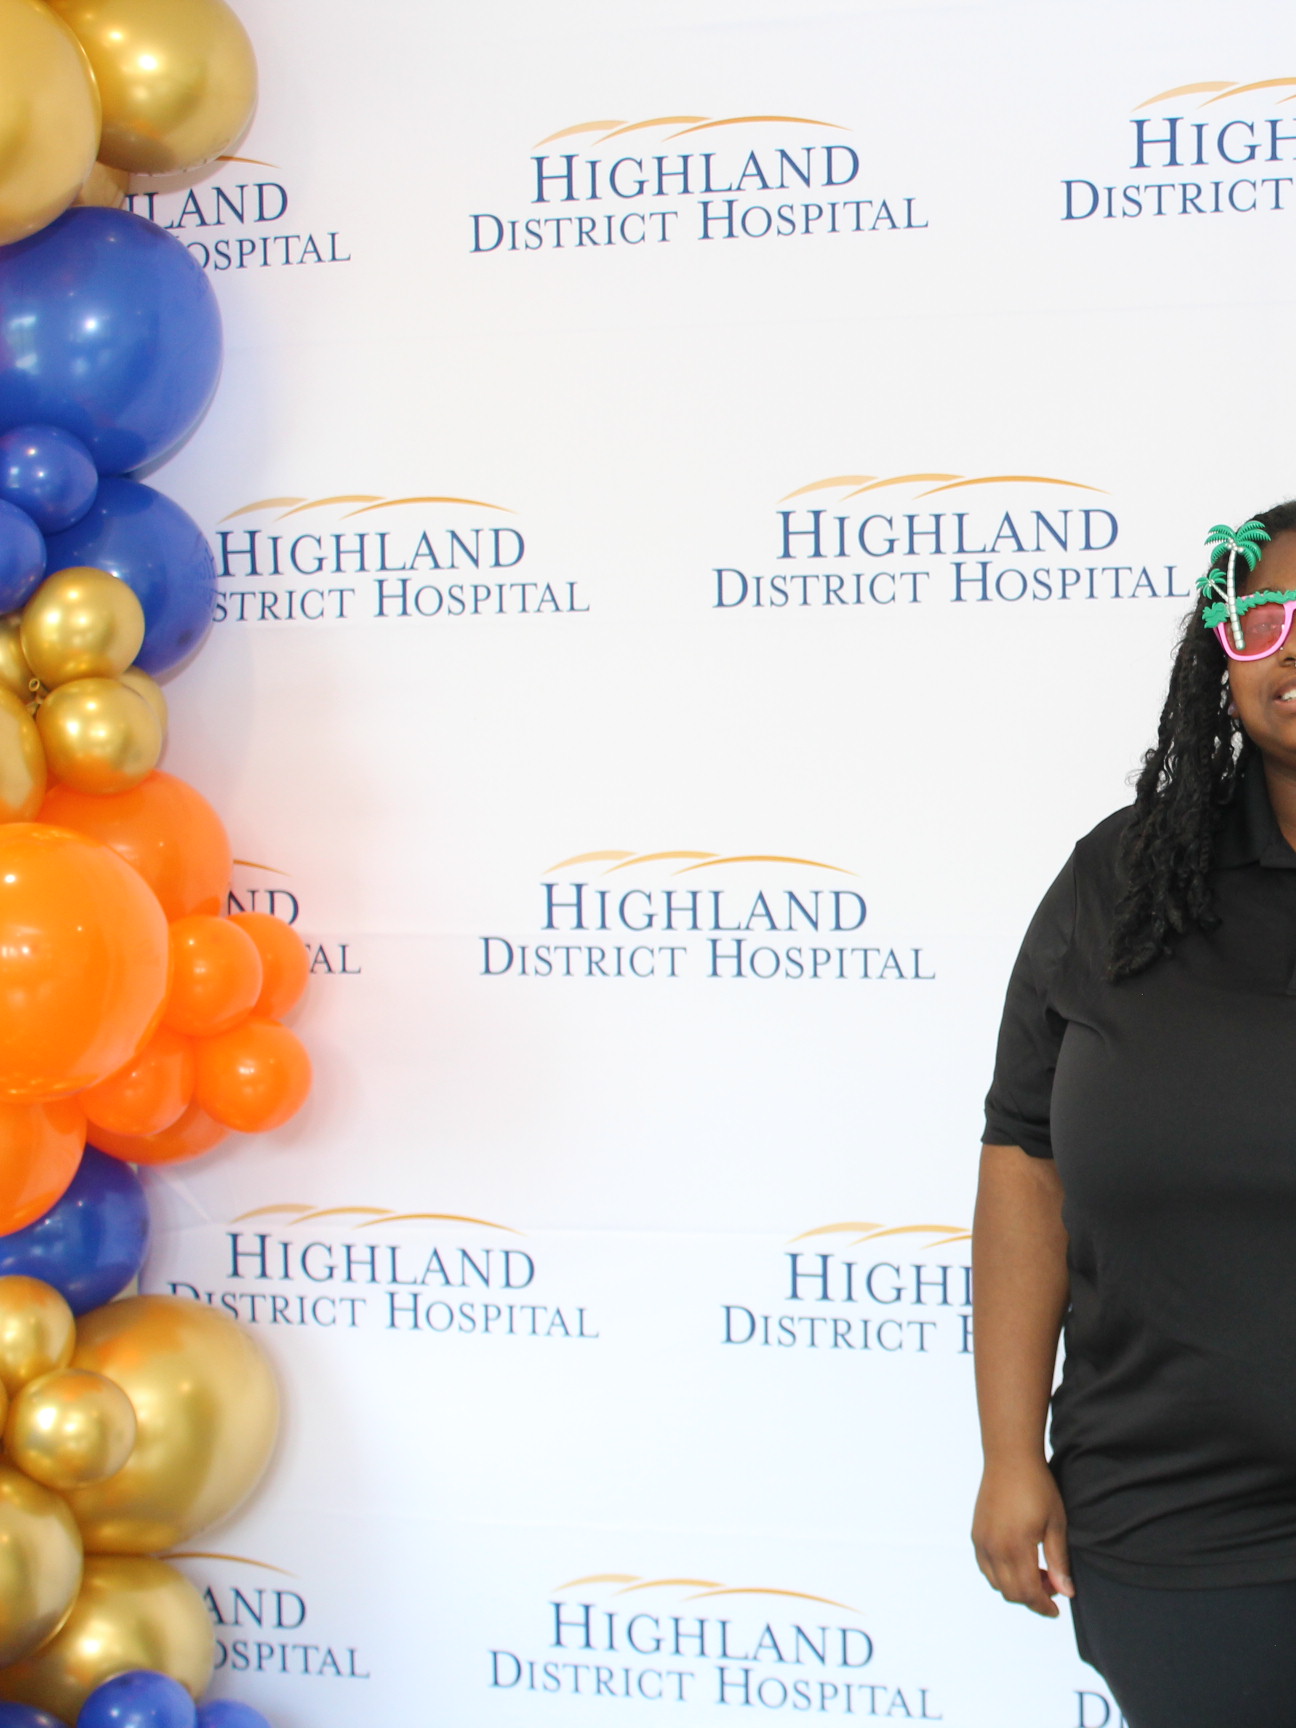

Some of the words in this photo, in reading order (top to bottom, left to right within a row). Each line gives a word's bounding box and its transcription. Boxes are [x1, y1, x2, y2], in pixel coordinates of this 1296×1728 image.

[528, 143, 861, 205] HIGHLAND
[1059, 175, 1295, 222] DISTRICT
[124, 180, 290, 231] LAND
[467, 209, 679, 254] DISTRICT
[696, 196, 930, 241] HOSPITAL
[214, 527, 526, 578] HIGHLAND
[775, 507, 1120, 561] HIGHLAND
[372, 576, 591, 619] HOSPITAL
[711, 566, 931, 610] DISTRICT
[949, 559, 1192, 603] HOSPITAL
[539, 881, 868, 933] HIGHLAND
[478, 935, 688, 979] DISTRICT
[706, 936, 937, 981] HOSPITAL
[223, 1231, 536, 1291] HIGHLAND
[384, 1290, 600, 1339] HOSPITAL
[721, 1304, 938, 1354] DISTRICT
[548, 1600, 875, 1670] HIGHLAND
[487, 1649, 696, 1704] DISTRICT
[714, 1664, 944, 1723] HOSPITAL
